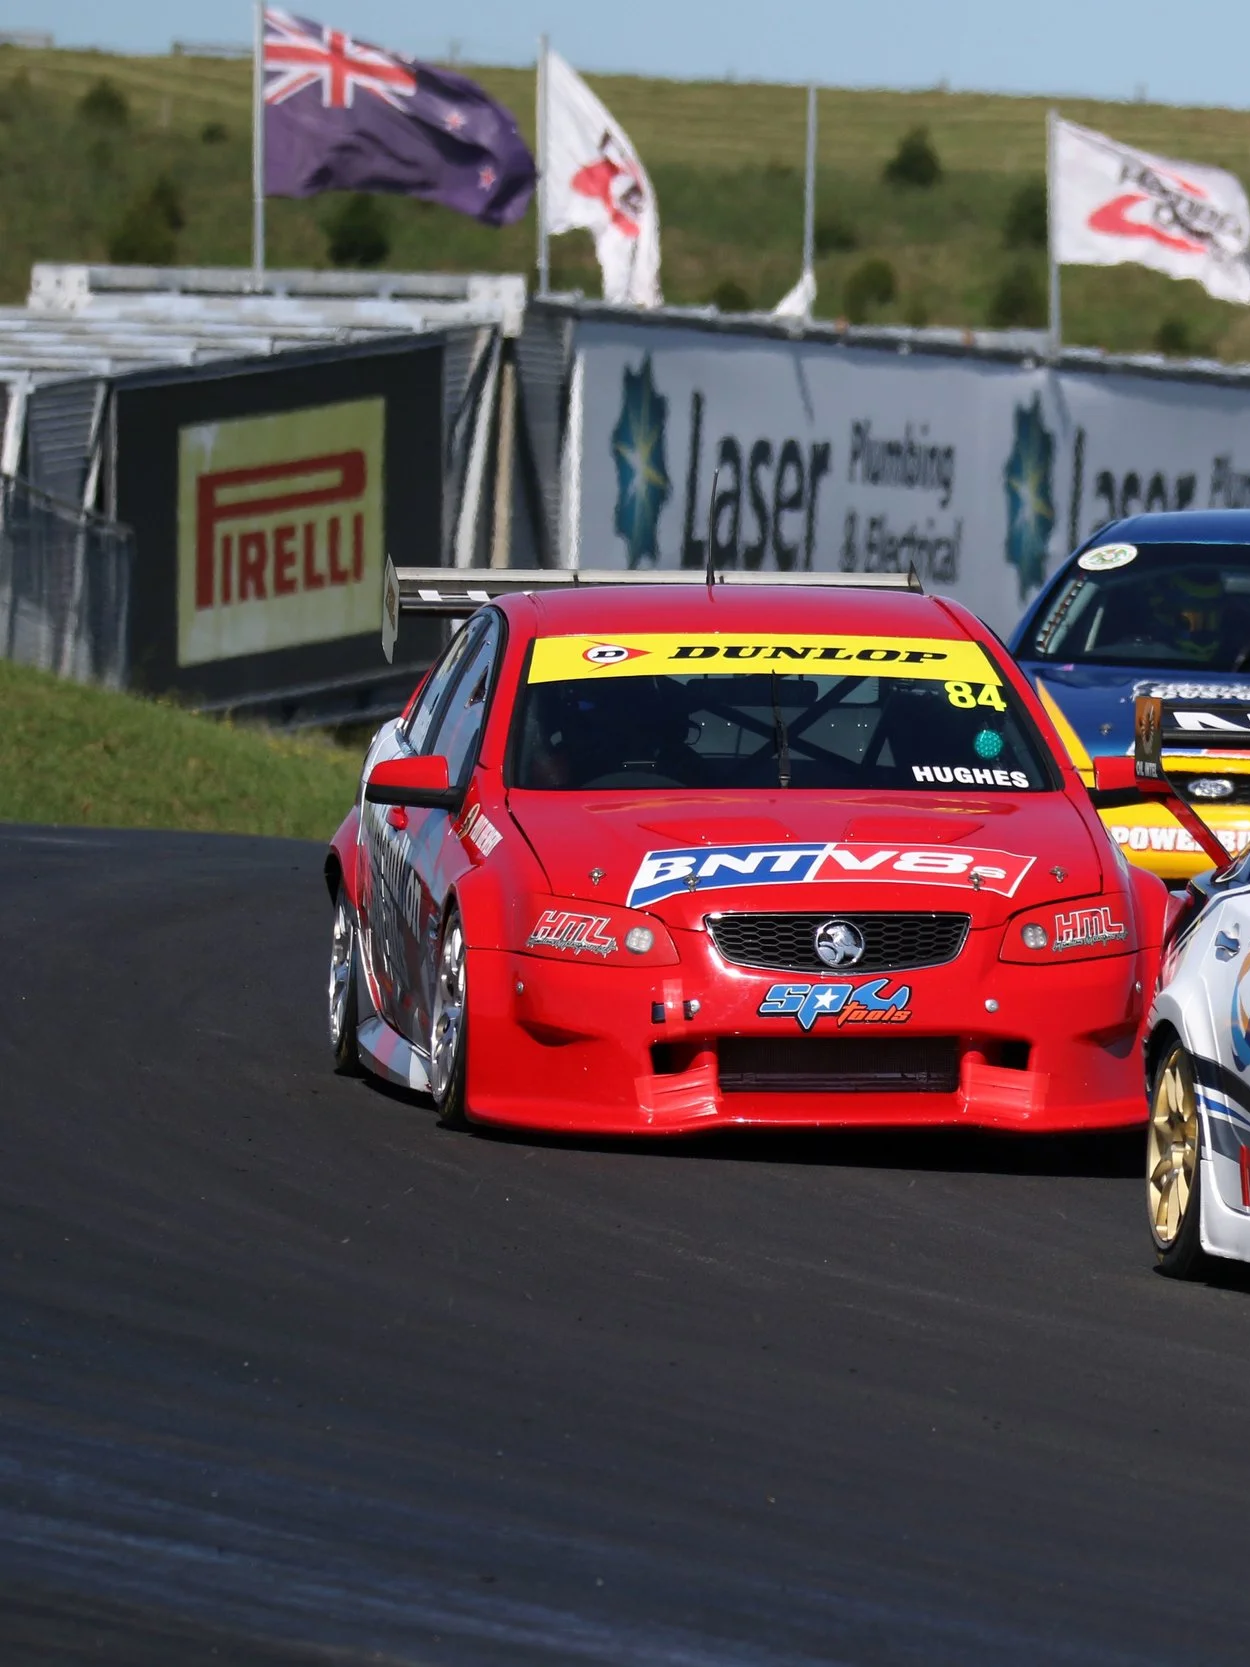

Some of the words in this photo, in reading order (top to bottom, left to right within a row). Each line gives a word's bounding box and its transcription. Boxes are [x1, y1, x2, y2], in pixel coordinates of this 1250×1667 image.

[681, 389, 831, 571] Laser
[849, 418, 955, 508] Plumbing
[195, 448, 368, 612] PIRELLI
[667, 645, 948, 664] DUNLOP
[944, 682, 1007, 713] 84
[912, 765, 1030, 789] HUGHES
[643, 851, 827, 889] BNT
[531, 910, 615, 948] HML
[1055, 907, 1124, 943] HML
[837, 1001, 913, 1027] tools
